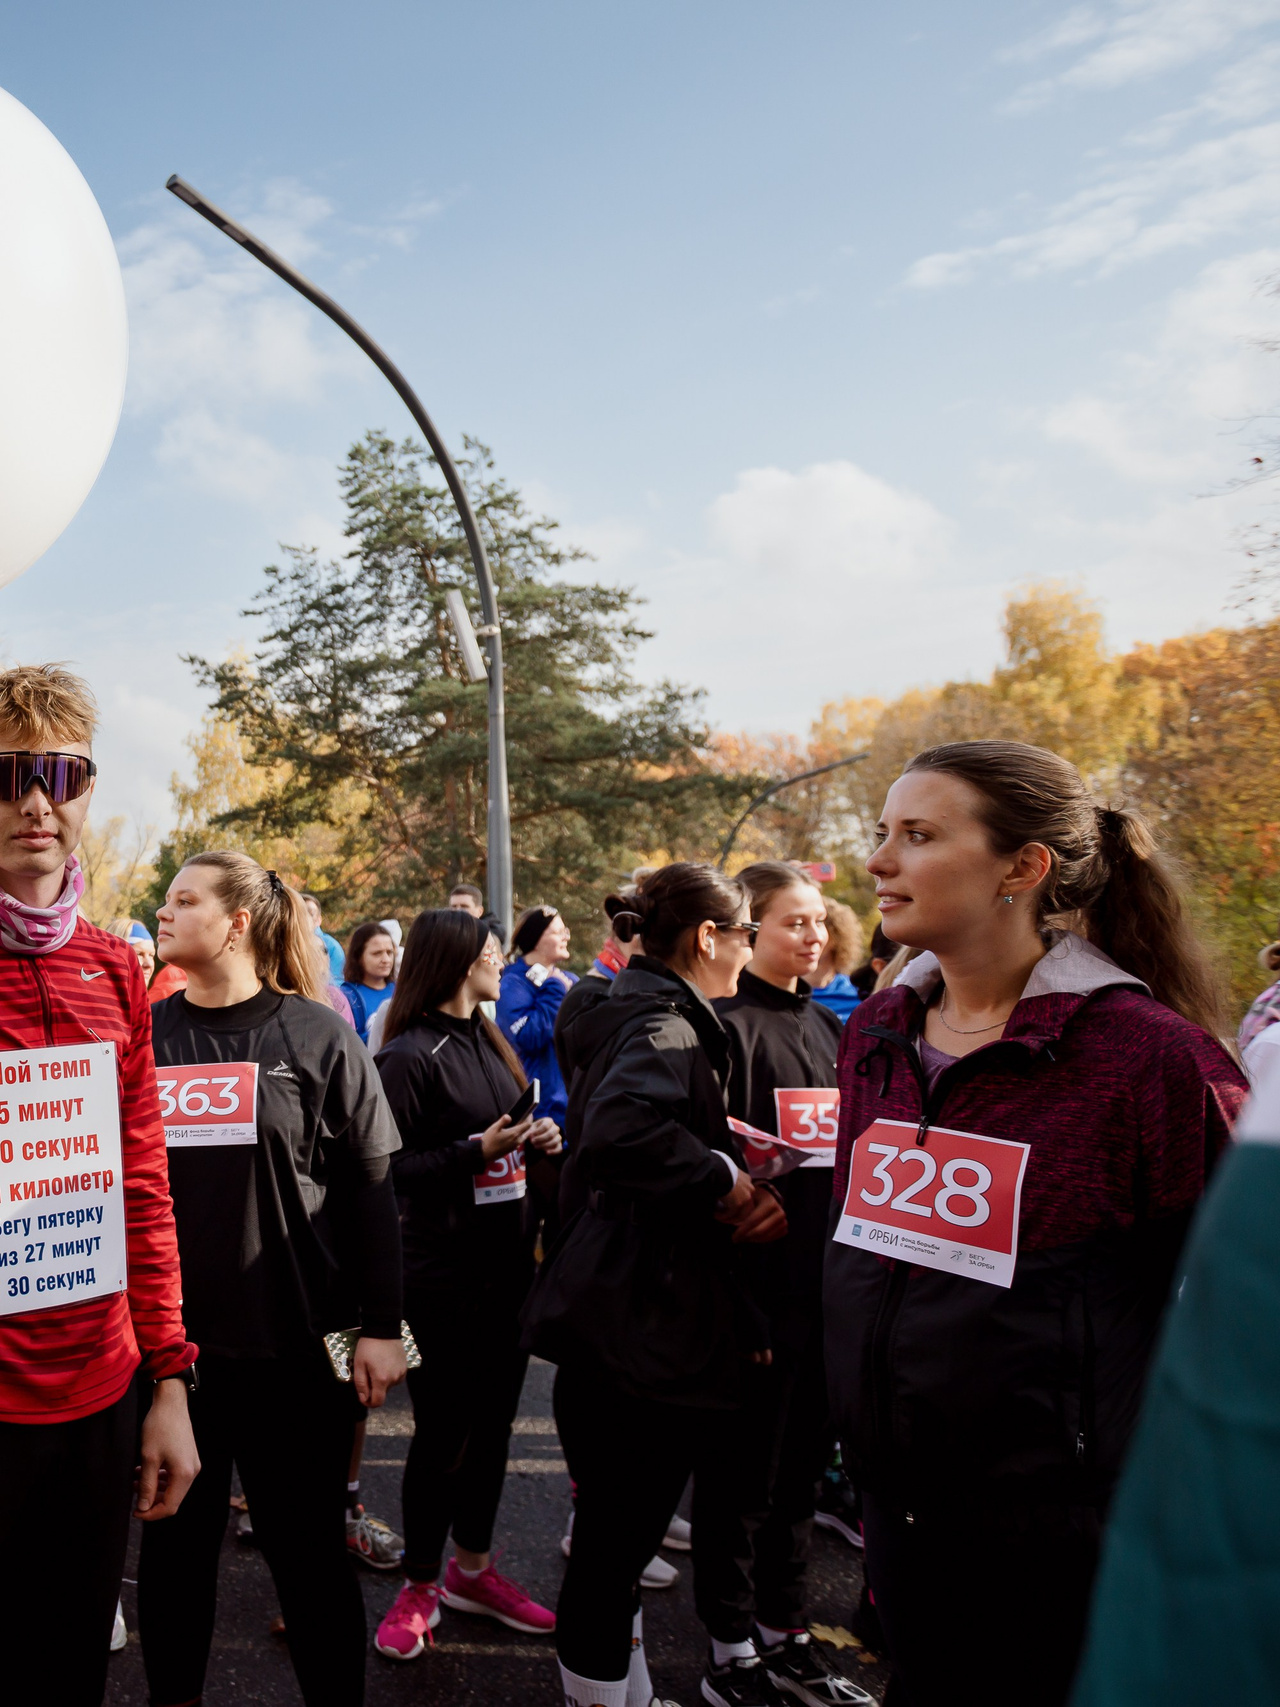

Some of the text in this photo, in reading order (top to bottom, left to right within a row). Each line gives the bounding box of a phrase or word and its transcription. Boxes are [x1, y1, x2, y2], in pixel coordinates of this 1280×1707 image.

[38, 1058, 91, 1081] темп
[18, 1097, 84, 1122] минут
[156, 1076, 240, 1118] 363
[789, 1102, 841, 1141] 35
[22, 1134, 100, 1161] секунд
[10, 1169, 114, 1202] километр
[859, 1142, 993, 1228] 328
[37, 1205, 104, 1231] пятерку
[24, 1242, 45, 1264] 27
[52, 1236, 102, 1259] минут
[868, 1228, 899, 1247] ОРБИ
[904, 1244, 936, 1256] инсультом
[917, 1239, 940, 1250] борьбы
[969, 1253, 986, 1261] БЕГУ
[7, 1267, 96, 1297] 30 секунд
